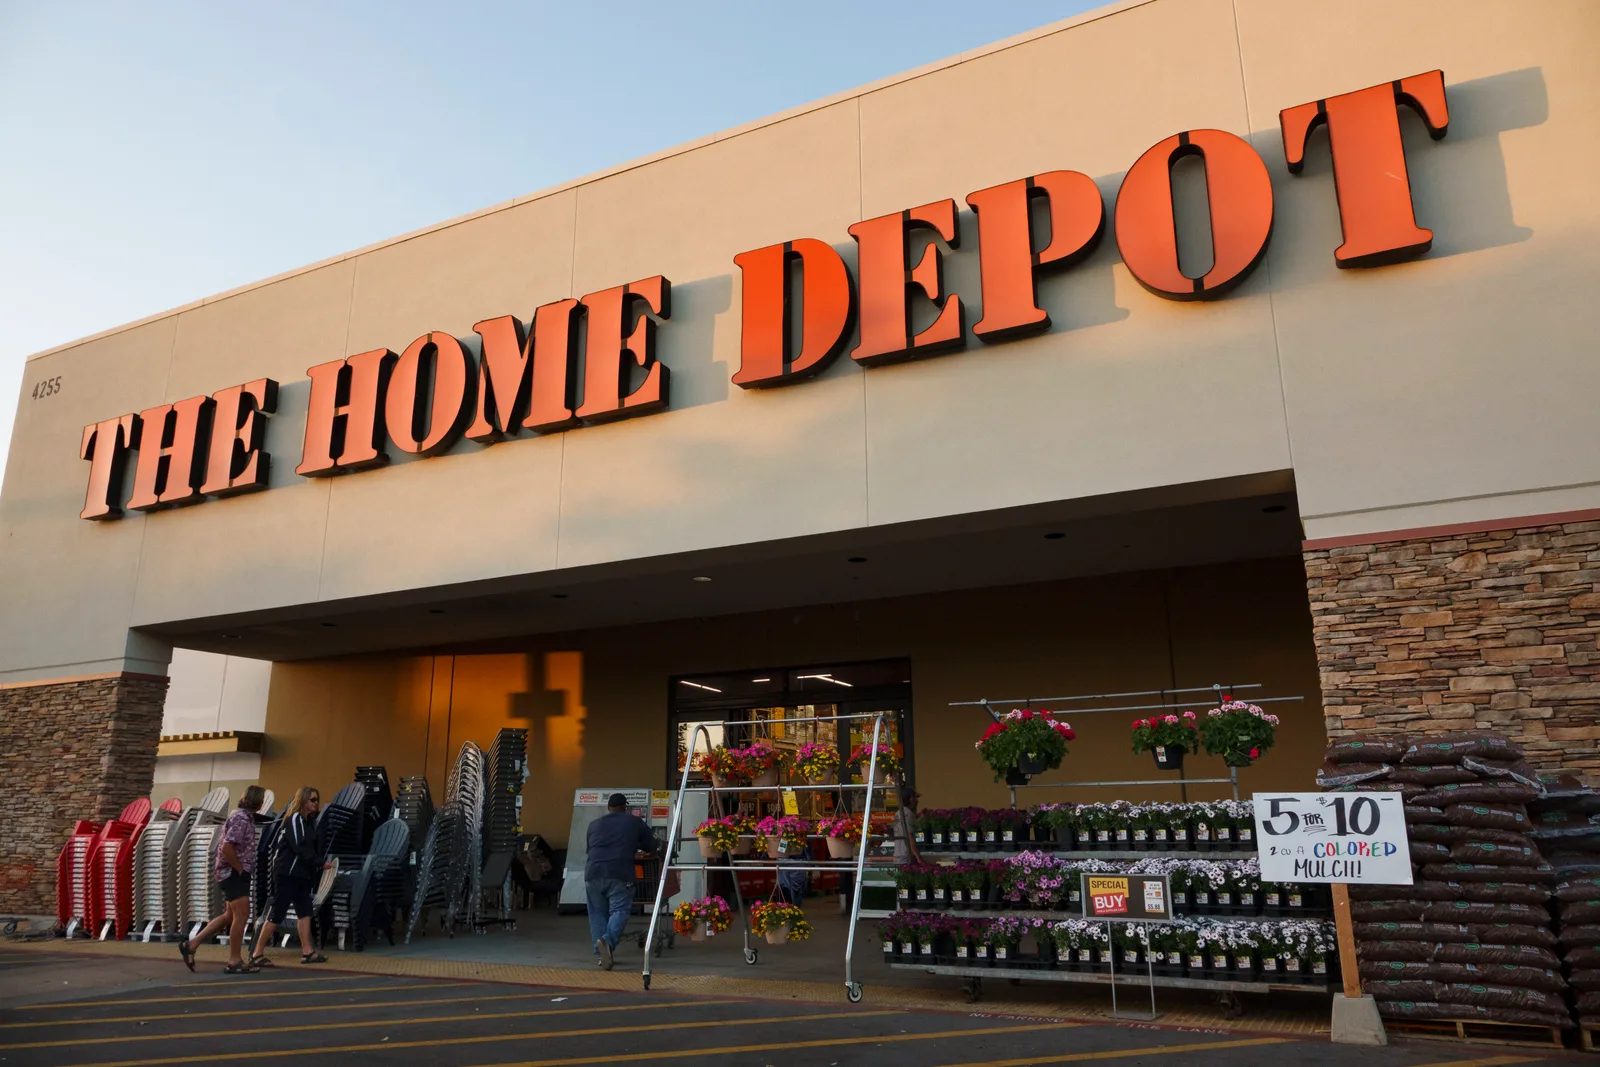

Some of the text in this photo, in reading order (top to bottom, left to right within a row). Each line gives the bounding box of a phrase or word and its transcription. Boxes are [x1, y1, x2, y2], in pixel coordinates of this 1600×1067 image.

[79, 69, 1450, 521] THE HOME DEPOT
[32, 376, 62, 400] 4255
[1262, 797, 1300, 835] 5
[1301, 813, 1323, 825] FOR
[1269, 846, 1277, 855] 2
[1314, 842, 1397, 858] COLORED
[1091, 880, 1126, 889] SPECIAL
[1094, 895, 1123, 908] BUY
[997, 1015, 1065, 1023] PARKING
